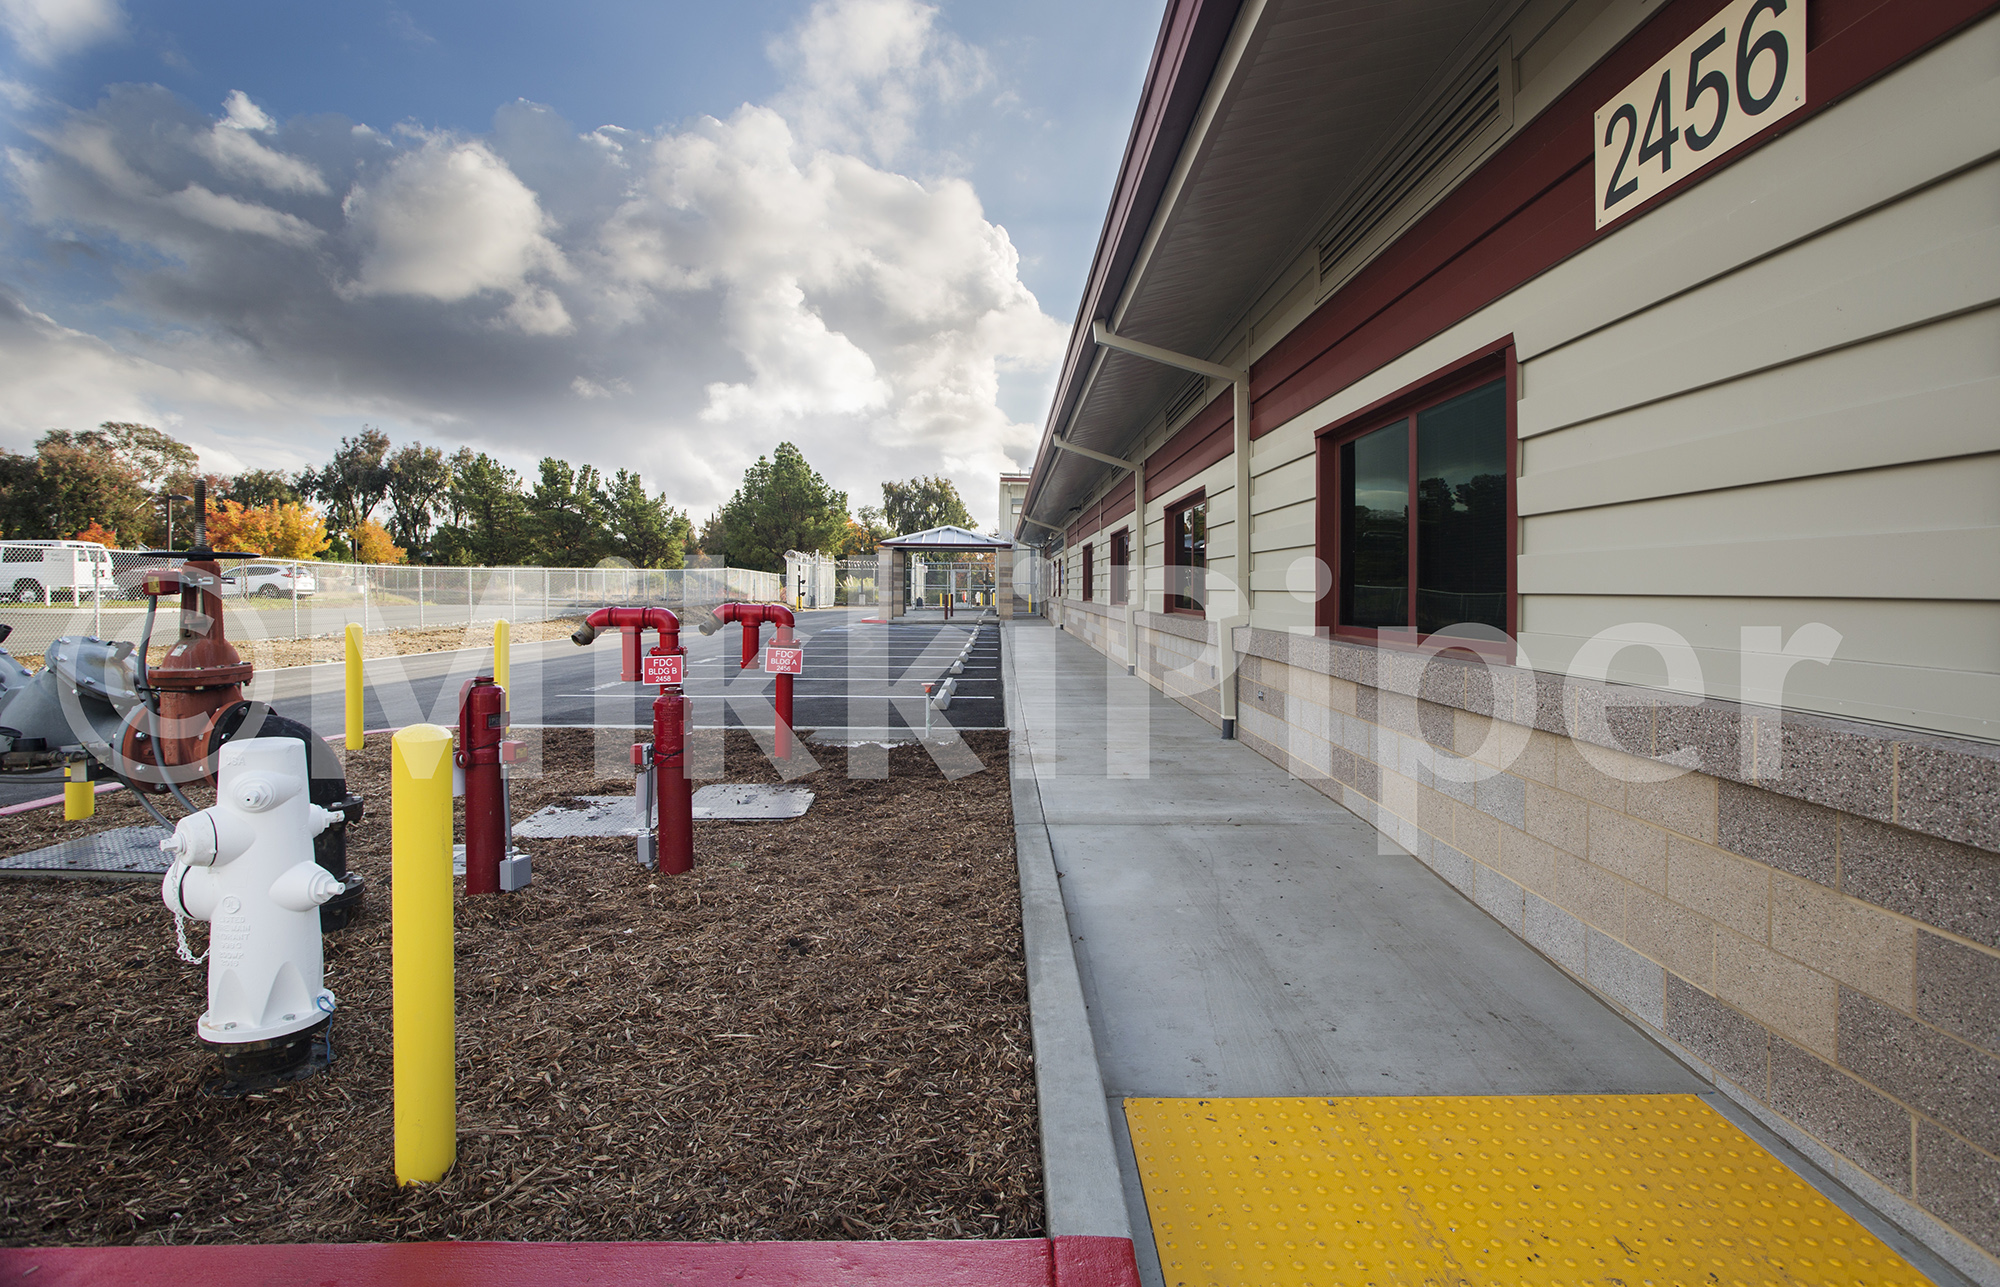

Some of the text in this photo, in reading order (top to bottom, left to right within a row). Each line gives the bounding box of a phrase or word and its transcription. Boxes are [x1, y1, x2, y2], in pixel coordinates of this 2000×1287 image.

[1603, 0, 1790, 211] 2456
[775, 650, 794, 658] FDC
[653, 658, 673, 667] FDC
[770, 658, 789, 666] BLDG
[648, 667, 678, 676] BLDG B
[655, 675, 672, 683] 2458
